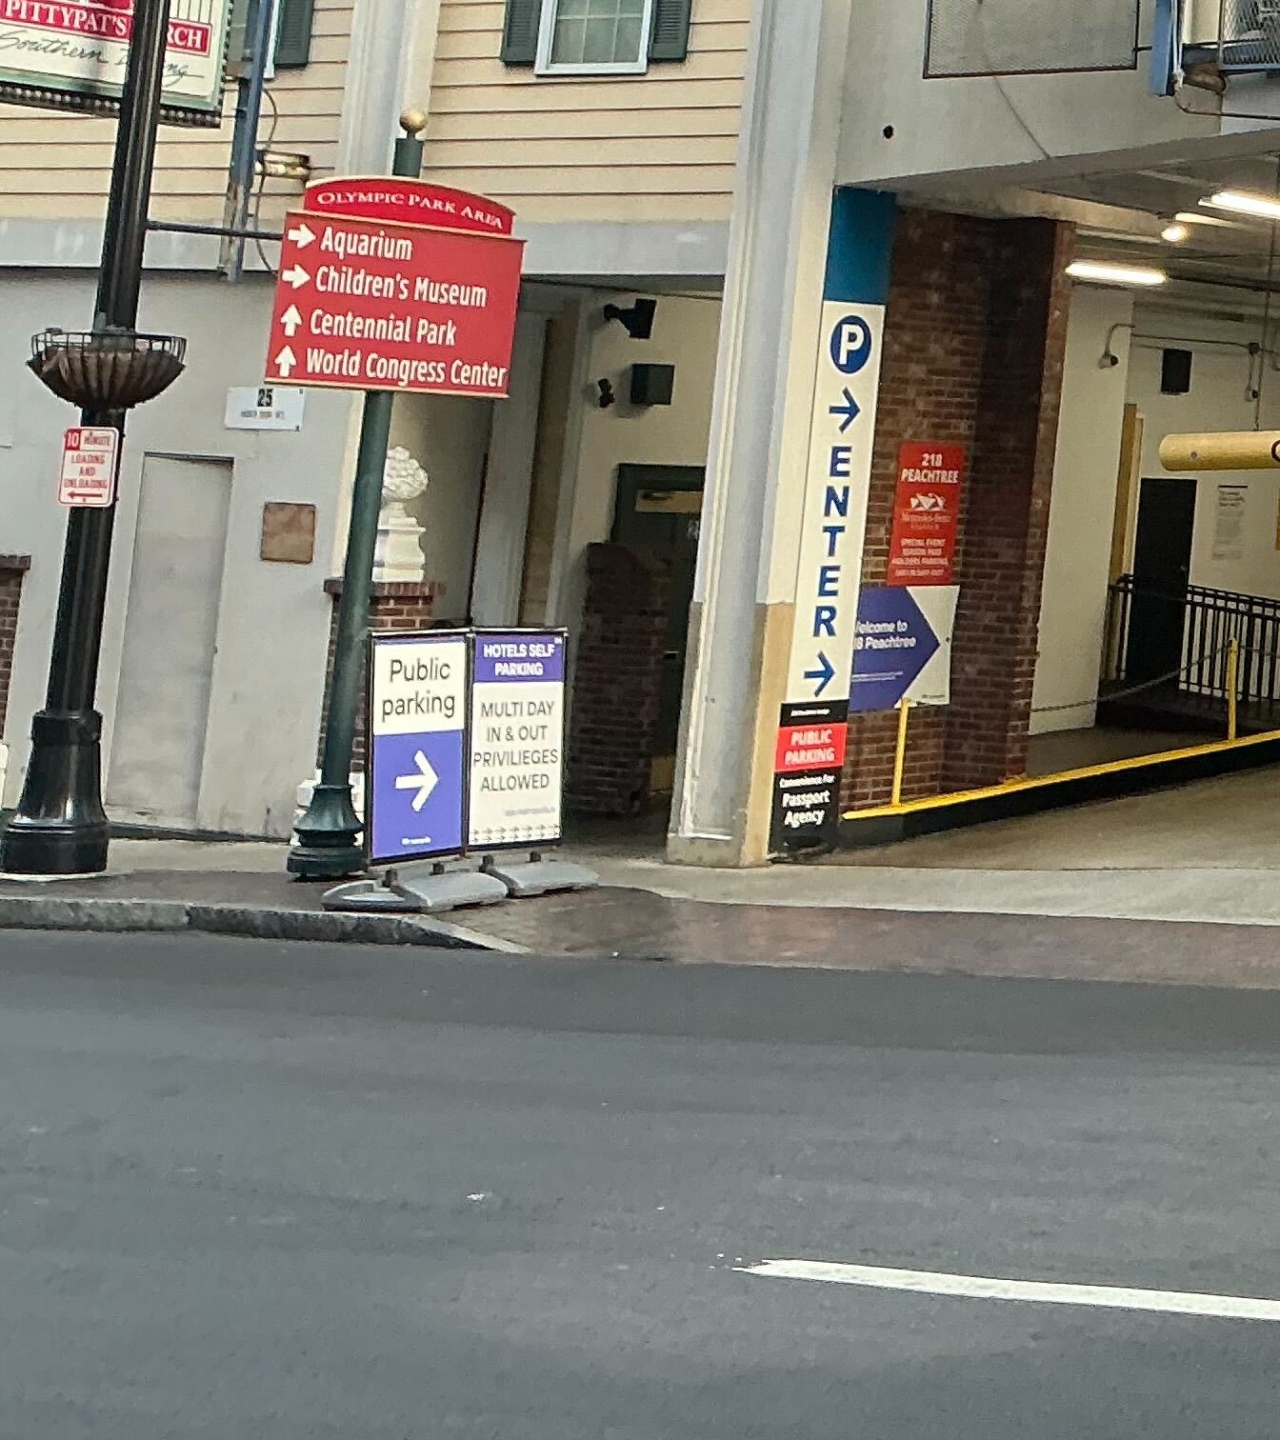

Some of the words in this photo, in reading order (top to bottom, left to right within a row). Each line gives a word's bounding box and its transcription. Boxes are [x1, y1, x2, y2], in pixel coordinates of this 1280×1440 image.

[0, 30, 109, 64] Southern
[167, 26, 203, 50] RCH
[317, 192, 404, 205] OLYMPIC
[408, 193, 455, 214] PARK
[461, 205, 503, 230] AREA
[320, 226, 412, 261] Aquarium
[316, 265, 409, 300] Children's
[414, 276, 487, 307] Museum
[310, 309, 411, 343] Centennial
[417, 318, 457, 346] Park
[838, 324, 865, 365] P
[306, 347, 361, 376] World
[366, 353, 446, 387] Congress
[451, 359, 508, 387] Center
[257, 388, 274, 407] 25
[67, 432, 80, 448] 10
[71, 454, 105, 464] LOADING
[921, 453, 943, 467] 218
[79, 467, 96, 477] AND
[900, 468, 959, 483] PEACHTREE
[63, 479, 107, 489] UNLOADING
[812, 445, 852, 637] ENTER
[856, 620, 896, 634] elcome
[897, 620, 908, 632] to
[483, 644, 527, 658] HOTELS
[529, 643, 555, 657] SELF
[865, 636, 917, 650] Peachtree
[389, 657, 451, 683] Public
[494, 662, 543, 677] PARKING
[381, 690, 456, 723] parking
[480, 701, 524, 718] MULTI
[526, 700, 555, 716] DAY
[486, 726, 501, 742] IN
[505, 726, 515, 741] &
[518, 725, 548, 741] OUT
[791, 729, 832, 747] PUBLIC
[473, 749, 558, 767] PRIVILIEGES
[785, 748, 834, 766] PARKING
[480, 774, 549, 792] ALLOWED
[782, 790, 830, 809] Passport
[784, 810, 825, 828] Agency
